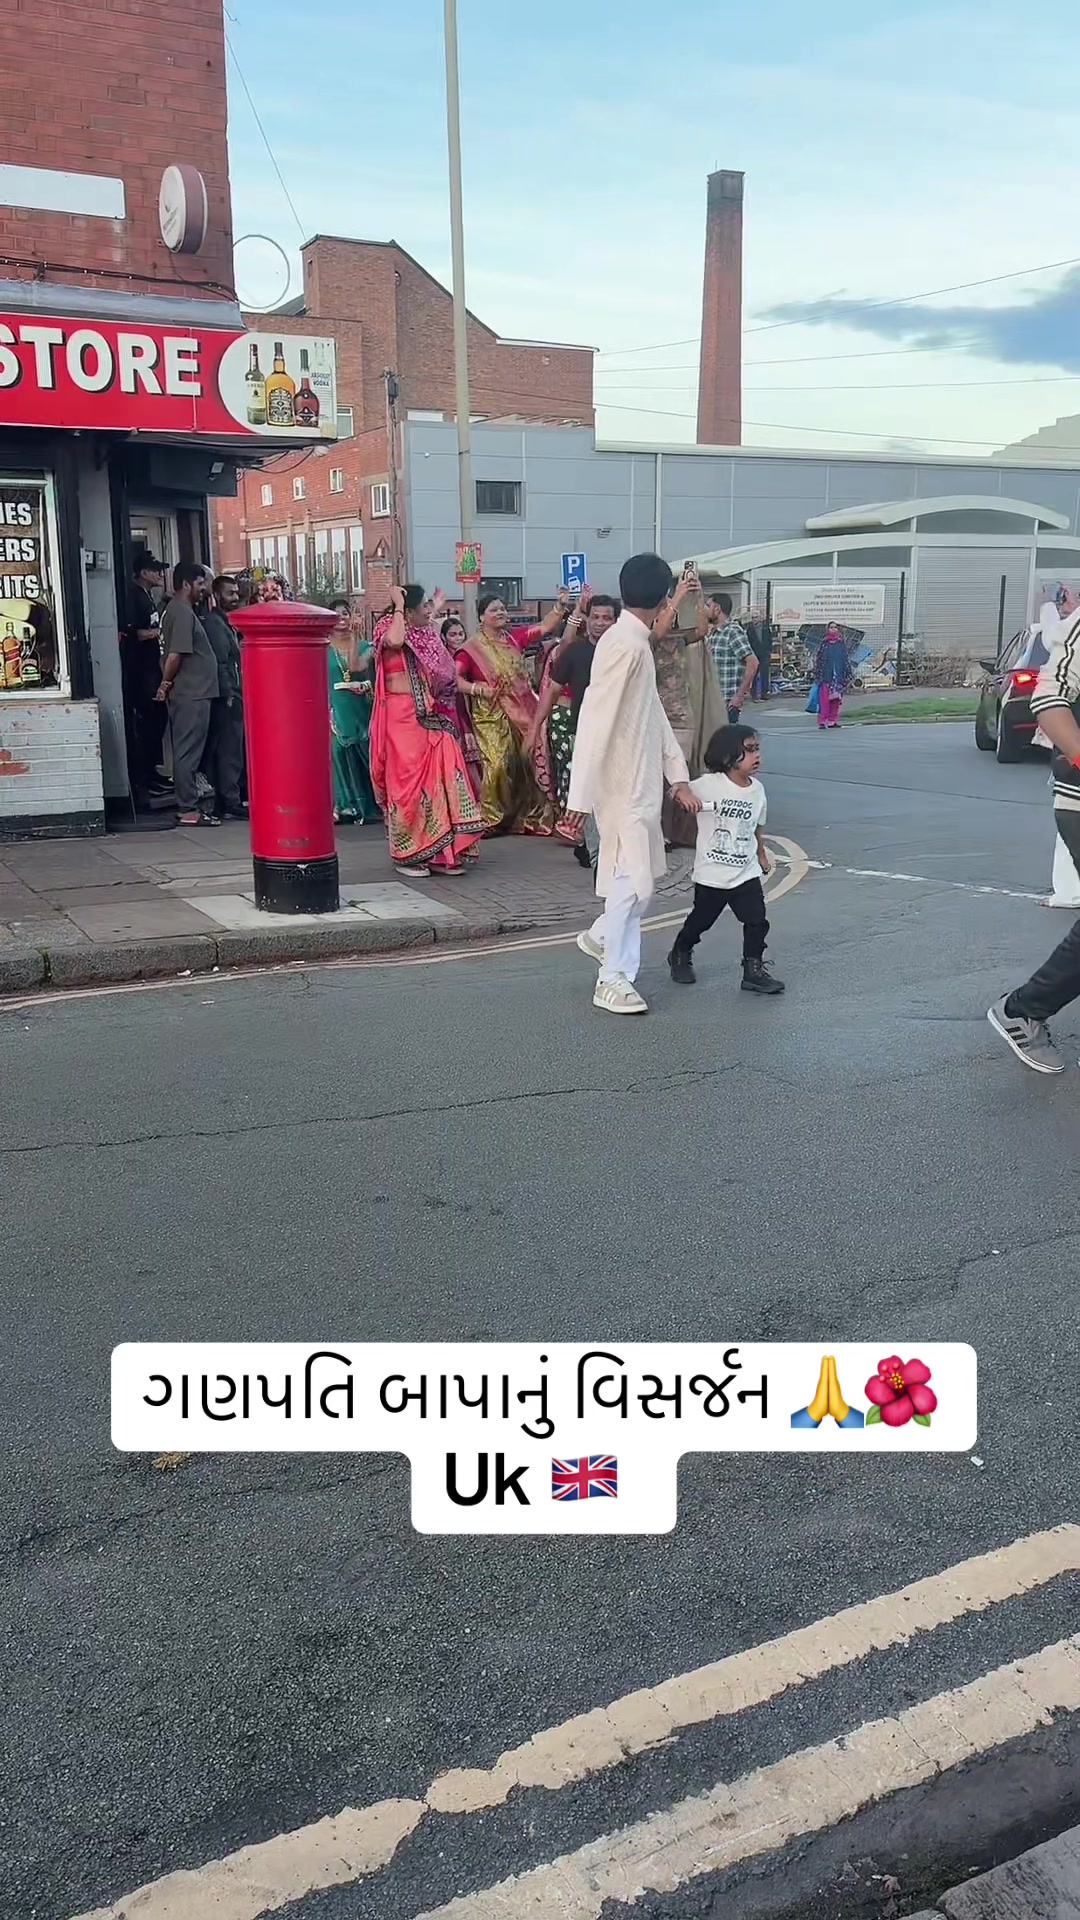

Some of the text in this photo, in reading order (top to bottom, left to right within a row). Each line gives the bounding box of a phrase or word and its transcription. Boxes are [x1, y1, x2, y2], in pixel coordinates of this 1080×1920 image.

[567, 556, 580, 574] P
[0, 574, 40, 599] ITS
[719, 807, 752, 820] HERO
